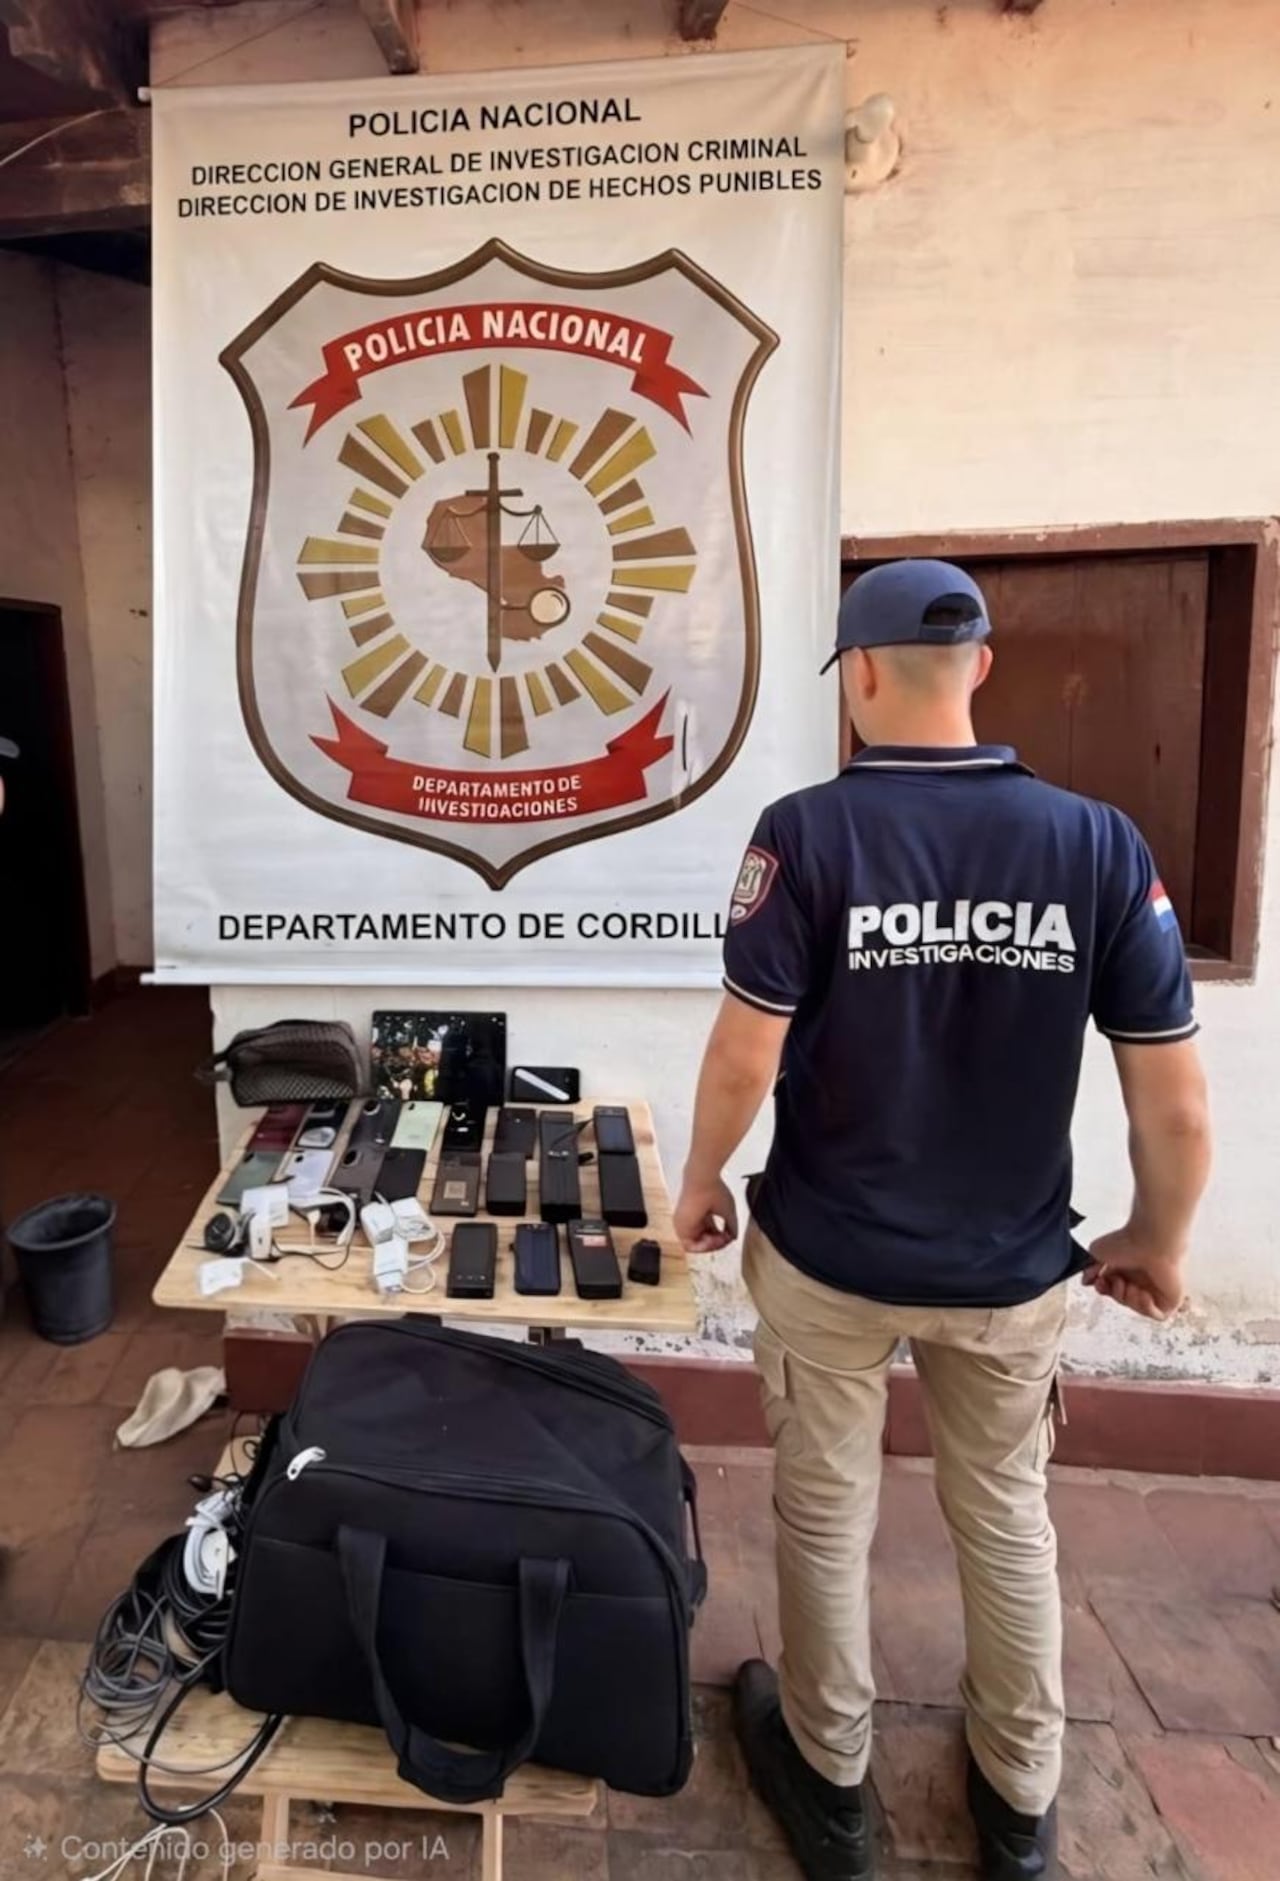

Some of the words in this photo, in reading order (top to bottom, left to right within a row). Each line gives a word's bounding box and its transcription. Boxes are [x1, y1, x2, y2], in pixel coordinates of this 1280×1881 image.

[348, 107, 471, 138] POLICIA
[480, 97, 642, 132] NACIONAL
[191, 161, 321, 186] DIRECCION
[329, 155, 443, 180] GENERAL
[450, 152, 482, 173] DE
[490, 143, 679, 171] INVESTIGACION
[687, 136, 807, 162] CRIMINAL
[178, 191, 307, 218] DIRECCION
[315, 191, 346, 212] DE
[354, 181, 540, 210] INVESTIGACION
[549, 179, 580, 201] DE
[589, 174, 691, 198] HECHOS
[700, 169, 822, 195] PUNIBLES
[343, 313, 470, 371] POLICIA
[482, 310, 645, 364] NACIONAL
[412, 775, 555, 797] DEPARTAMENTO
[558, 775, 582, 792] DE
[218, 913, 506, 940] DEPARTAMENTO
[518, 913, 565, 939] DE
[577, 912, 726, 939] CORDILL
[848, 900, 1076, 951] POLICIA
[848, 943, 1075, 973] INVESTIGACIONES
